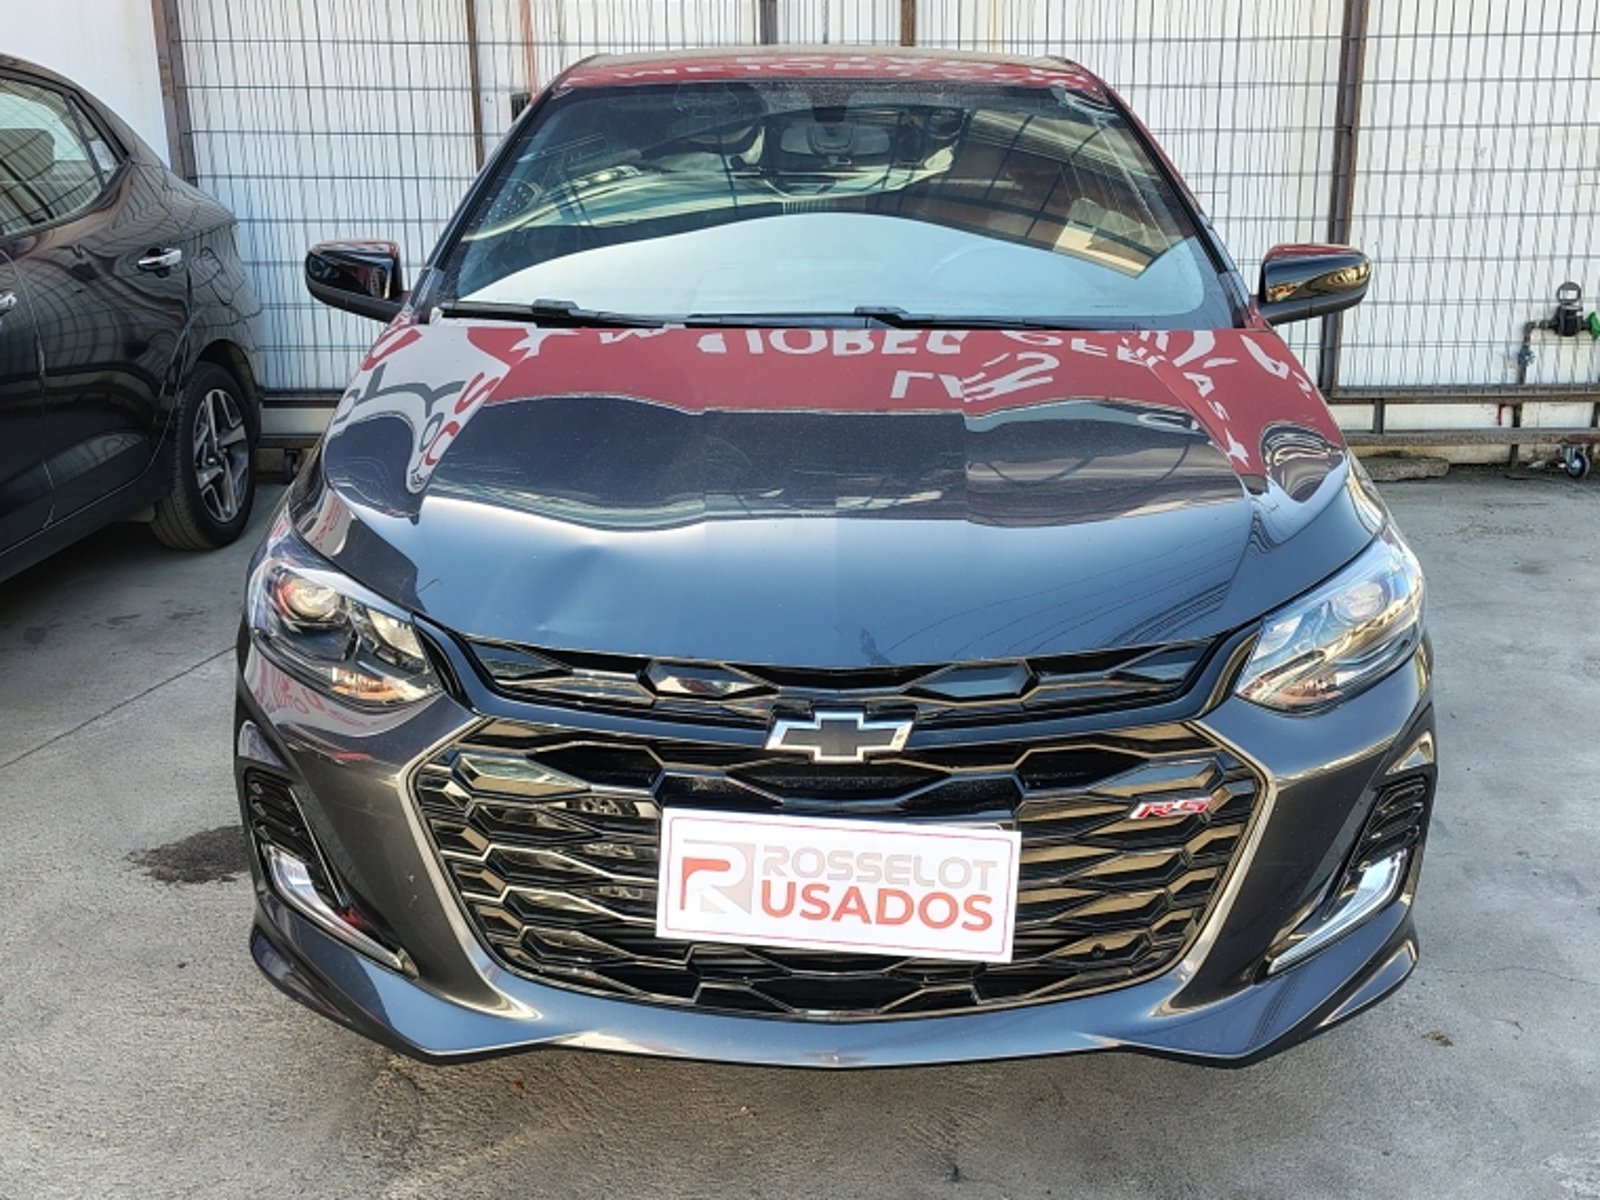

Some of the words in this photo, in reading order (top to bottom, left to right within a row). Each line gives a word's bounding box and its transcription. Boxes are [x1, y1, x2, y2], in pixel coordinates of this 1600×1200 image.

[1130, 799, 1210, 819] RS
[761, 845, 998, 891] ROSSELOT
[761, 880, 993, 931] USADOS
